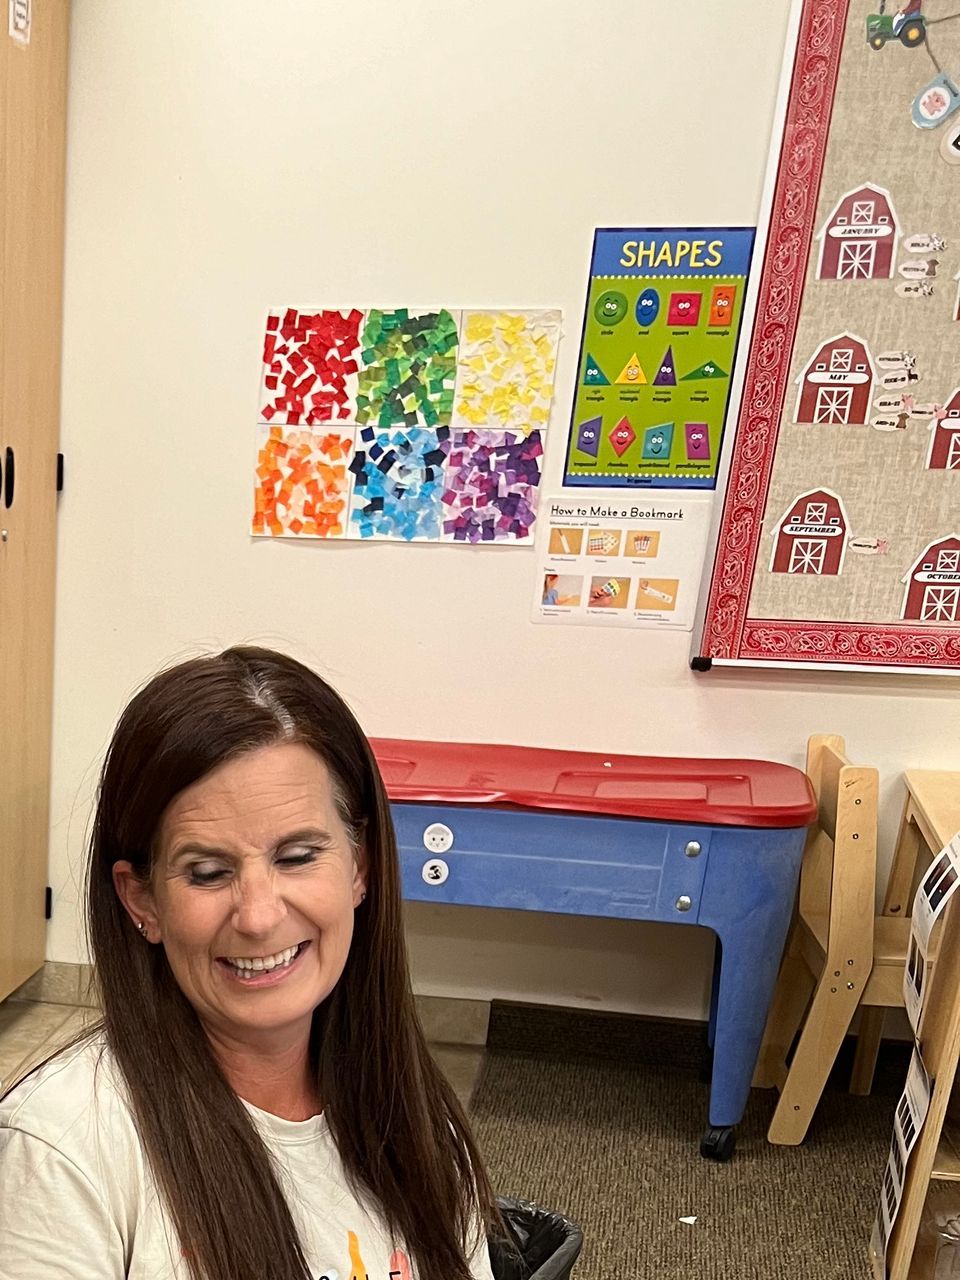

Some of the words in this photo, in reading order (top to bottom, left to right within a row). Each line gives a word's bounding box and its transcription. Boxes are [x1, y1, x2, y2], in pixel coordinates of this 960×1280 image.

[619, 240, 723, 268] SHAPES
[551, 505, 574, 516] How
[577, 507, 587, 516] to
[590, 506, 618, 517] Make
[630, 507, 684, 519] Bookmark
[789, 526, 837, 534] SEPTEMBER
